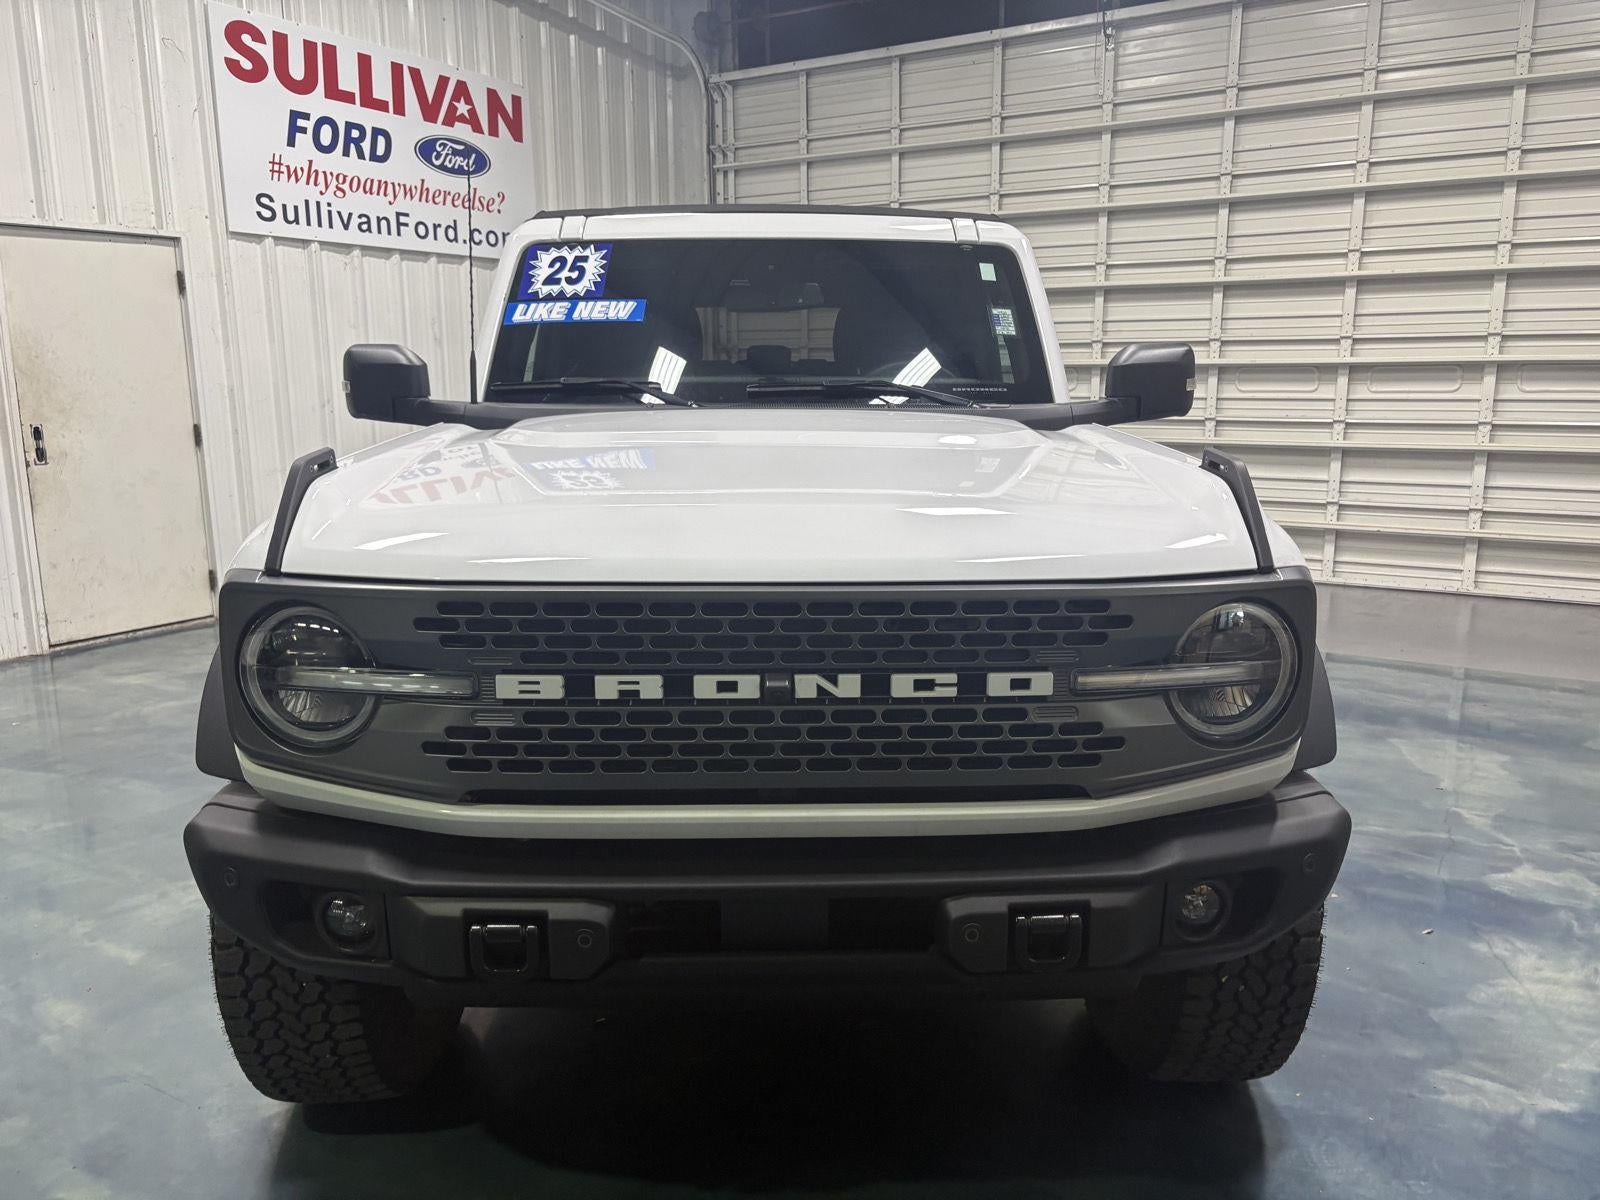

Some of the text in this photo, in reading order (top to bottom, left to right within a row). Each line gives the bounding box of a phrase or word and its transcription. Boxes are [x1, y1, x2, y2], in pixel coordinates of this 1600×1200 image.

[223, 19, 524, 144] SULLIVAN
[286, 109, 393, 164] FORD
[432, 140, 476, 172] Ford
[268, 153, 506, 214] #whygoanywhereelse?
[541, 255, 590, 287] 25
[512, 301, 638, 323] LIKE NEW
[495, 671, 1054, 700] BRONCO
